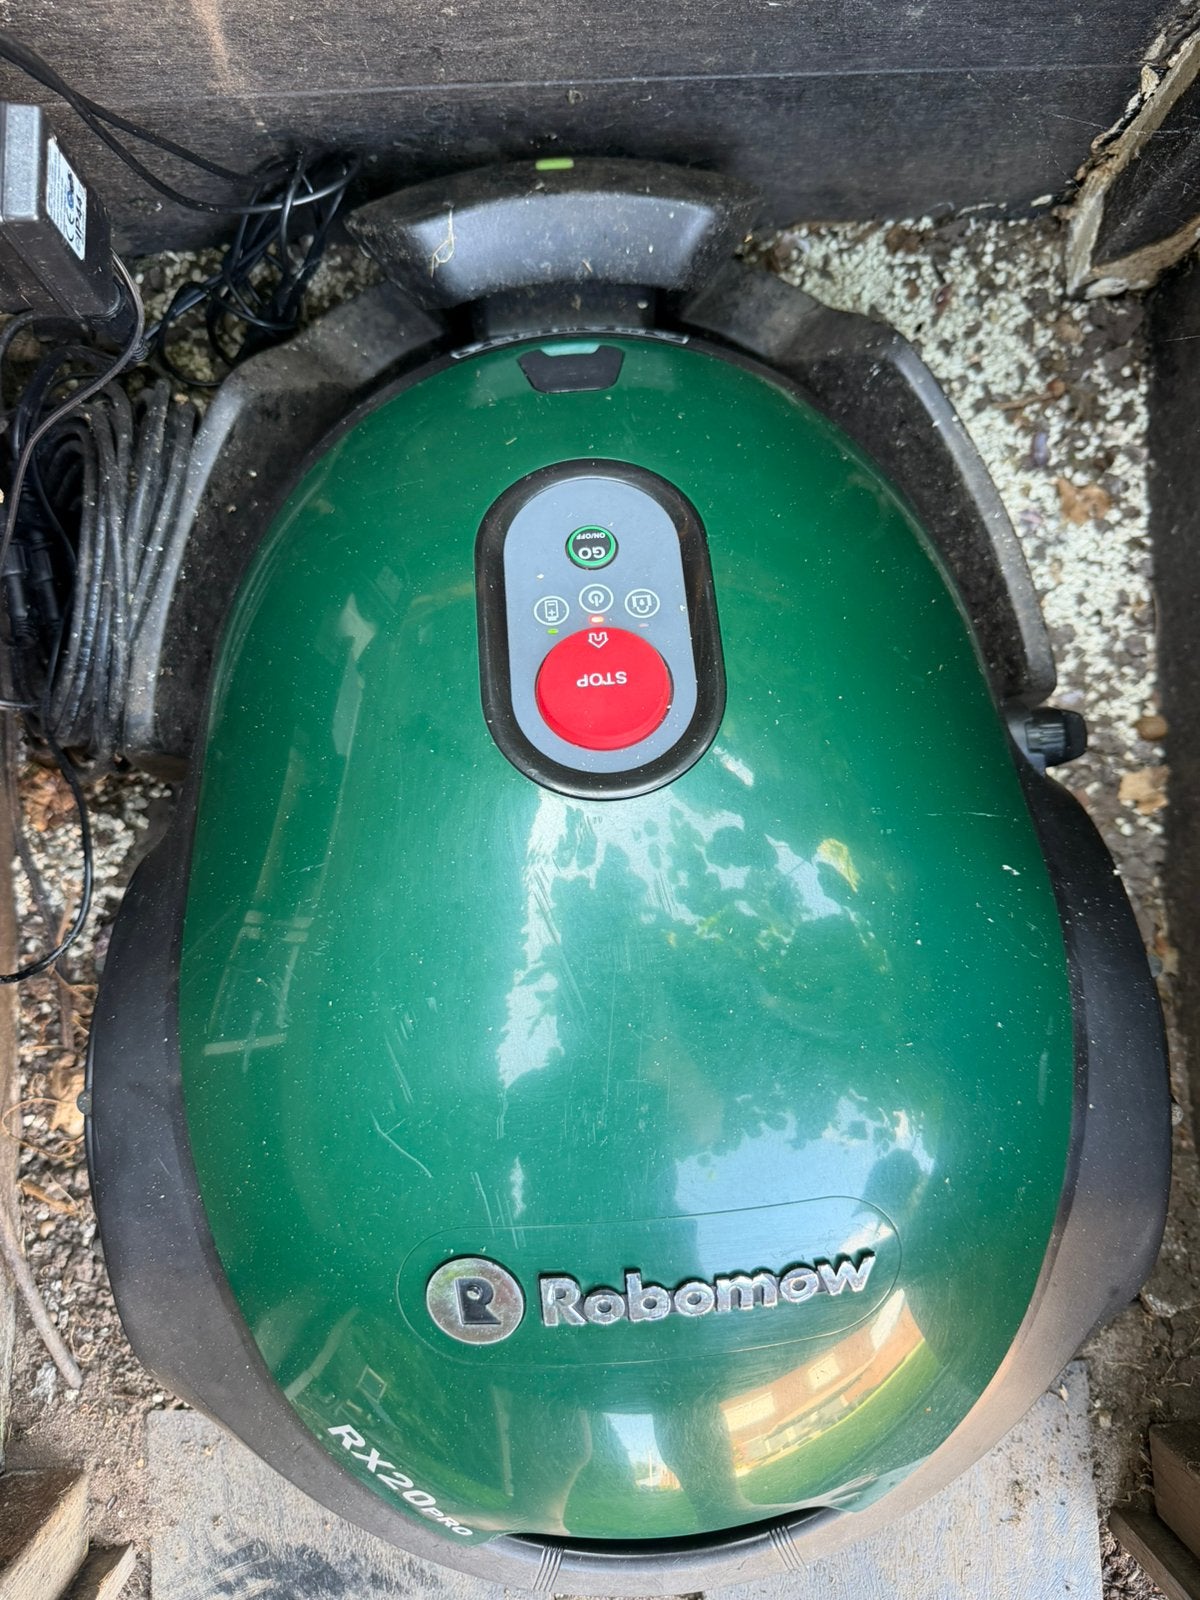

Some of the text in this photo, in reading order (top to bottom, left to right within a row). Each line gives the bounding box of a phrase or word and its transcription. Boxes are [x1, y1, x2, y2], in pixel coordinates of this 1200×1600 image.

[576, 532, 606, 541] ON/OFF
[577, 546, 606, 560] GO
[576, 670, 628, 688] STOP
[538, 1249, 876, 1327] Robomow
